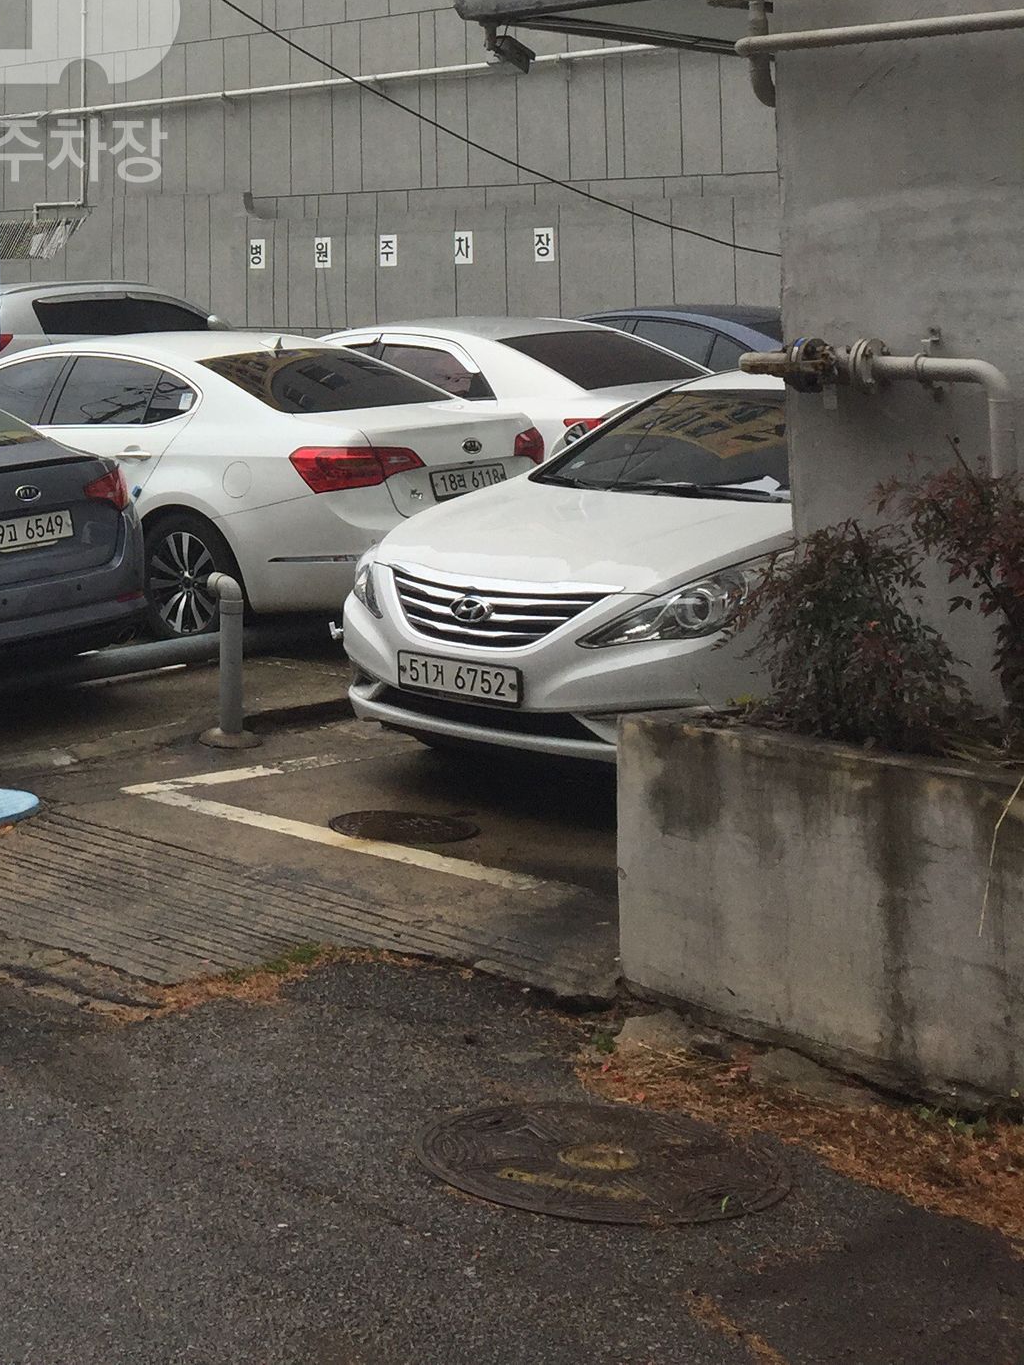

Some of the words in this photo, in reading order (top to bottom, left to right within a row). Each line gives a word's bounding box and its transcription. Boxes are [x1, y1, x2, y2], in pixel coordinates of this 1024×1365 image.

[472, 468, 502, 488] 6118
[25, 514, 64, 540] 6549
[454, 665, 507, 697] 6752
